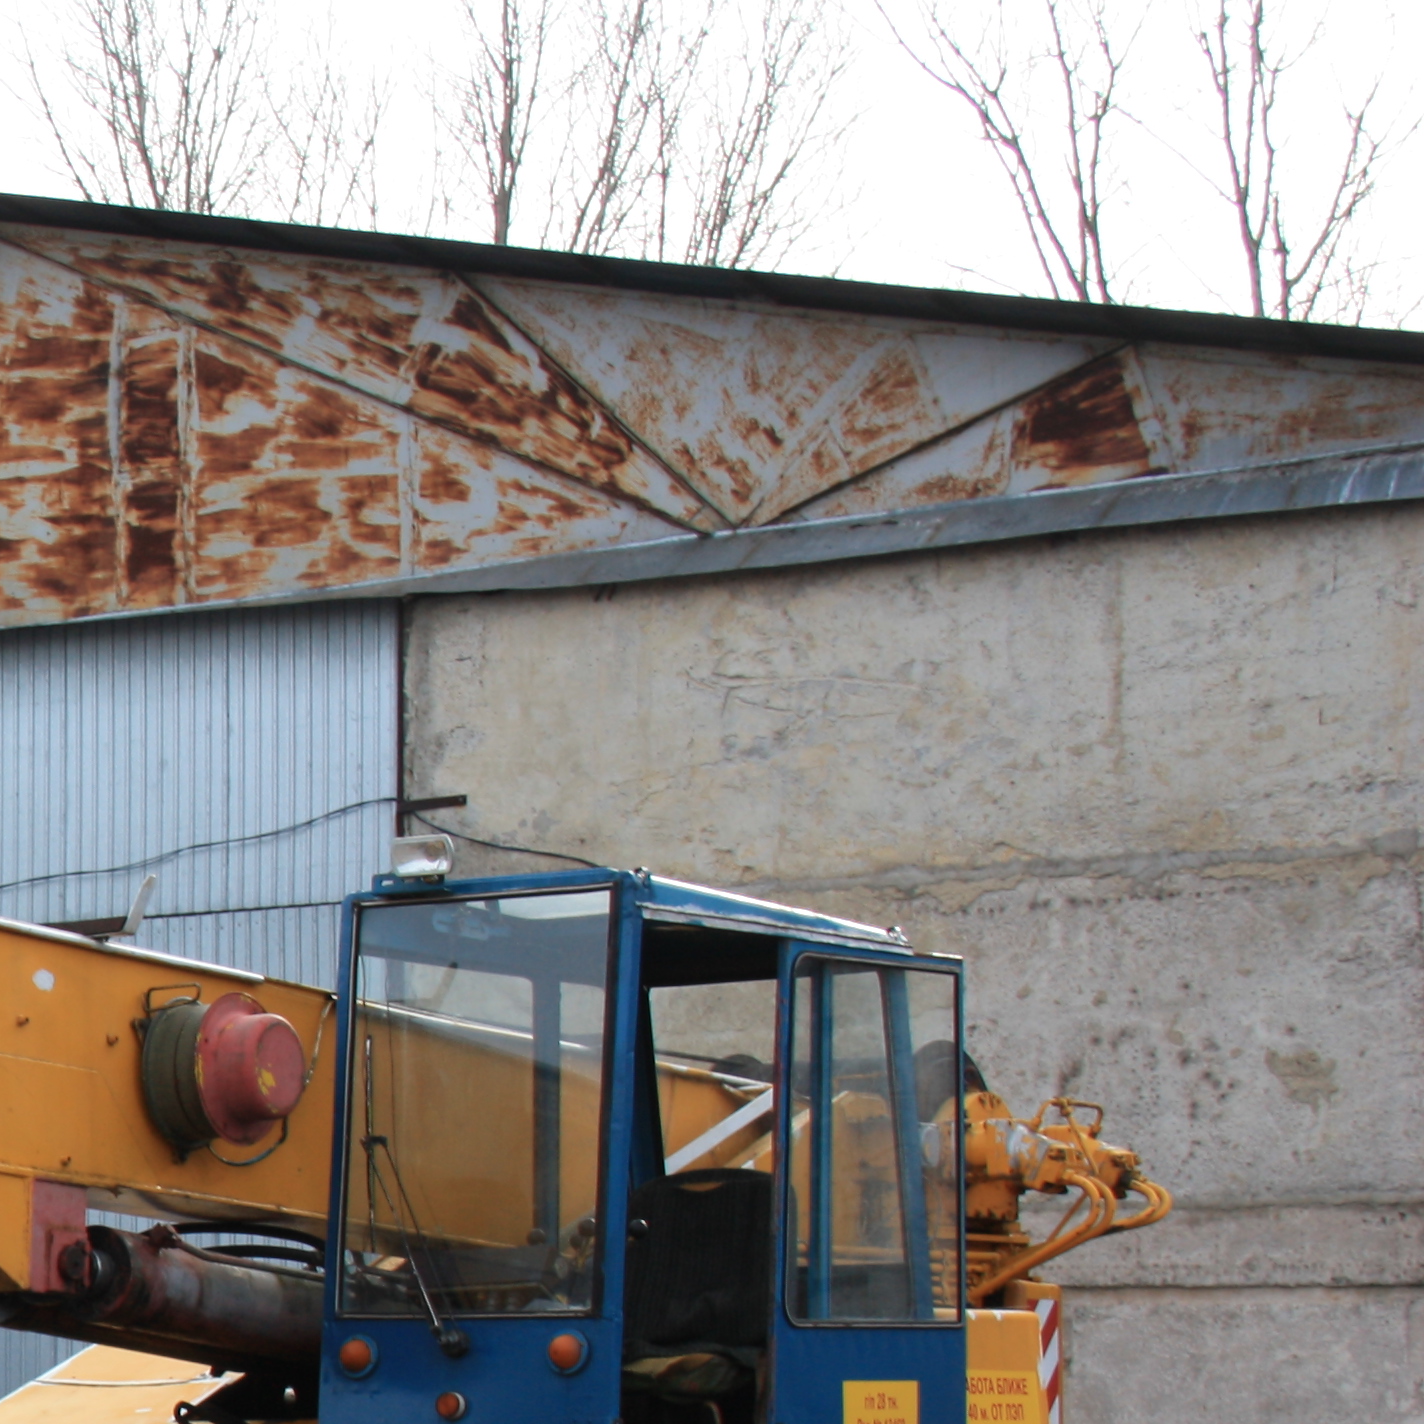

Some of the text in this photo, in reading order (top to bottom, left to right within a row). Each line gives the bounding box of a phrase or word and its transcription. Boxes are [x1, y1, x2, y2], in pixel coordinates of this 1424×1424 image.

[996, 1378, 1028, 1395] БЛИЖЕ
[877, 1393, 886, 1410] 28
[968, 1403, 978, 1420] 40
[991, 1403, 1003, 1420] ОТ
